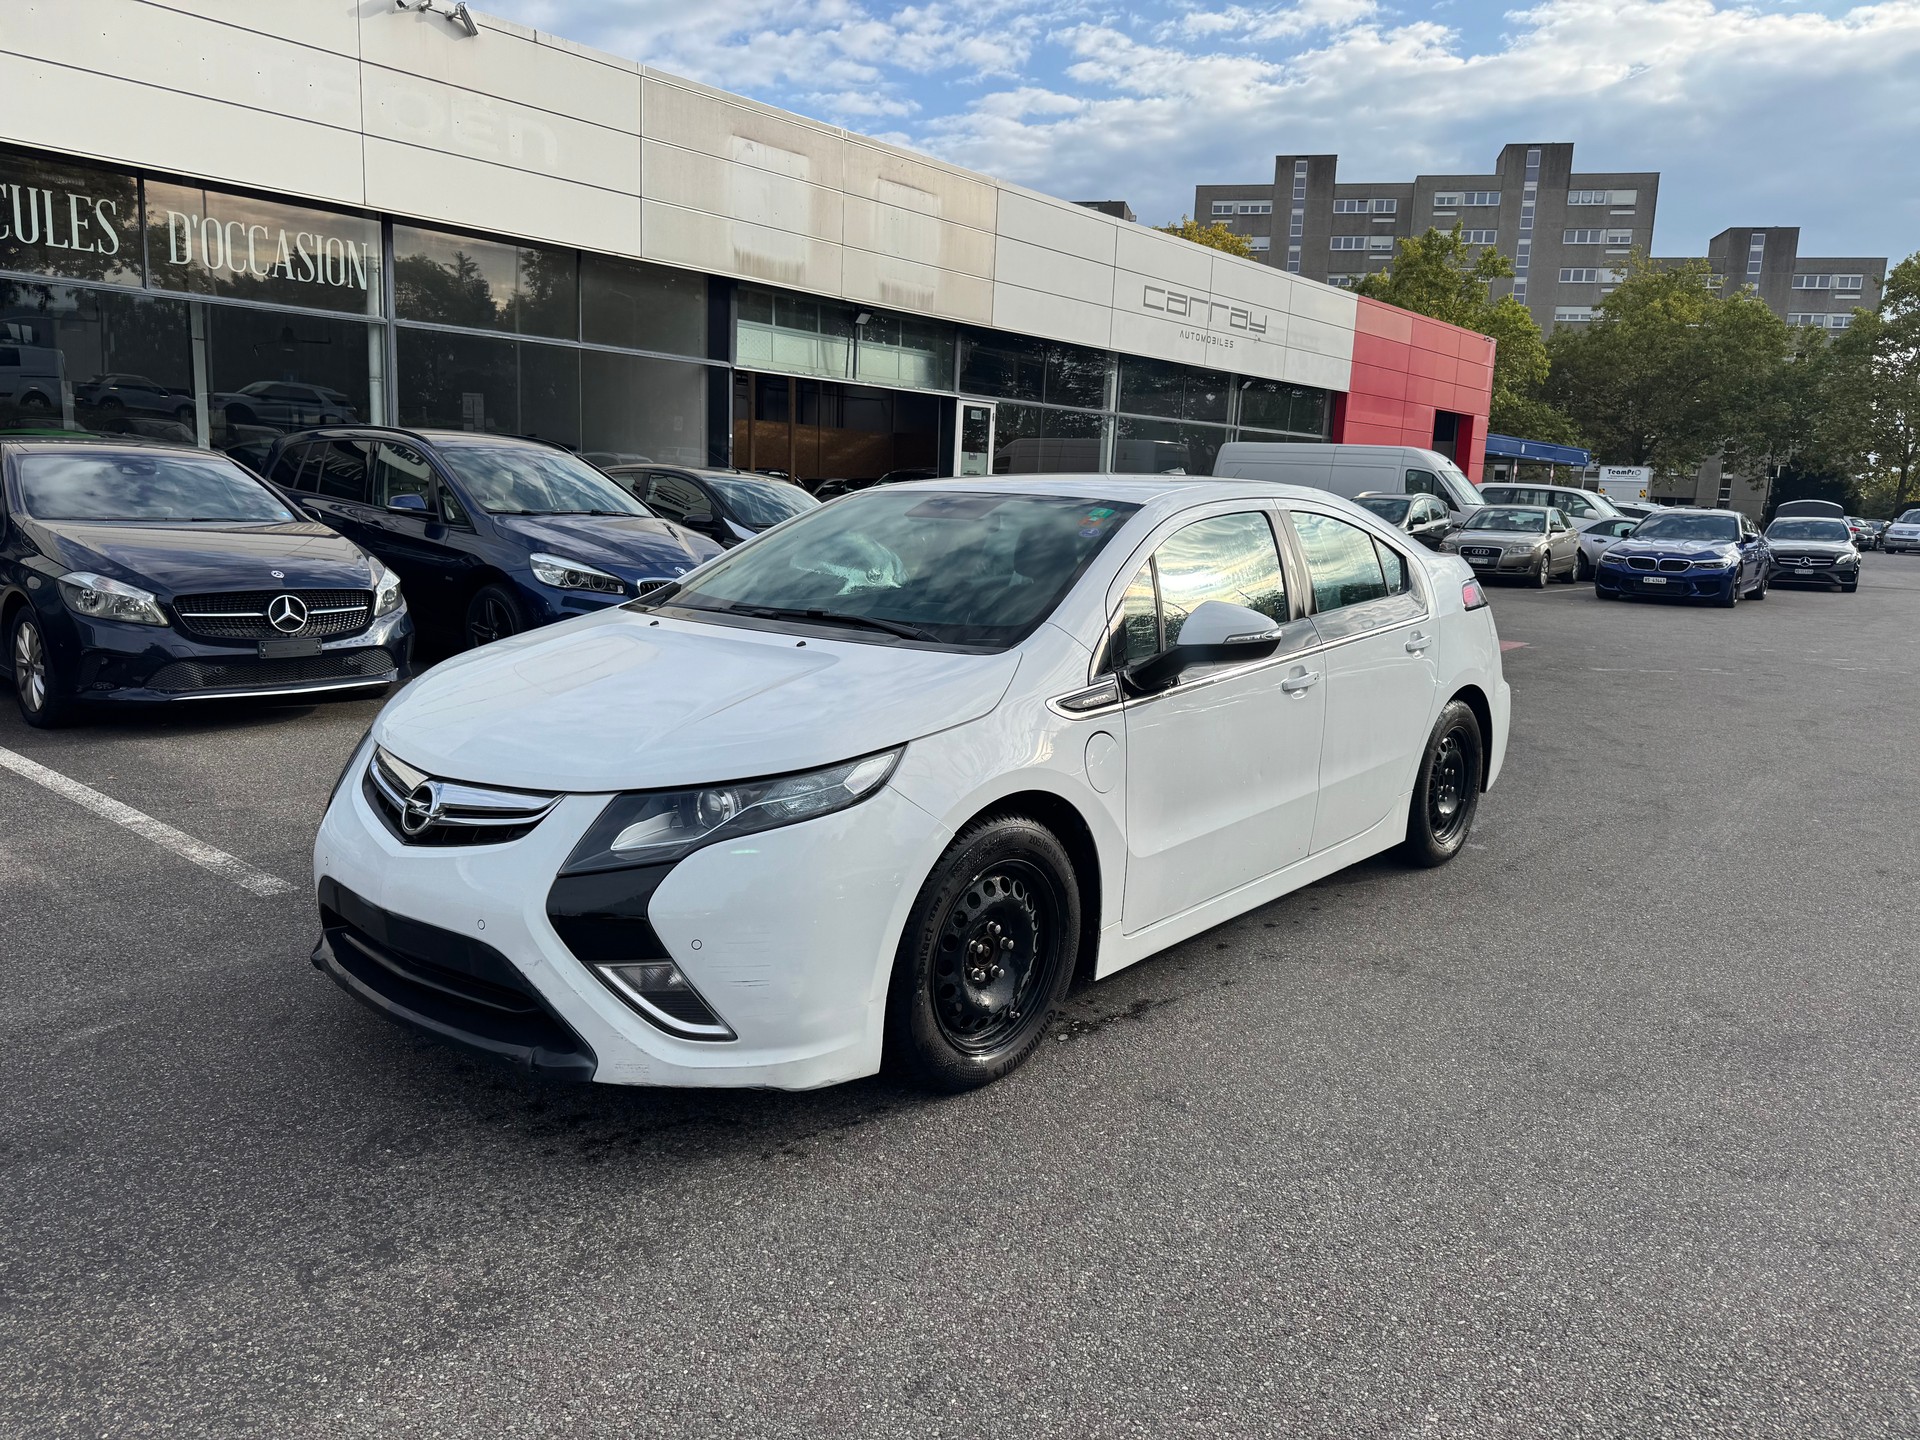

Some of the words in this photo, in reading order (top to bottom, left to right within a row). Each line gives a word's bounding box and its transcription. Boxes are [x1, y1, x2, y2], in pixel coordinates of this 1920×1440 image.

[167, 210, 368, 290] D'OCCASION
[1143, 284, 1267, 334] carray
[1179, 330, 1234, 349] AUTOMOBILES
